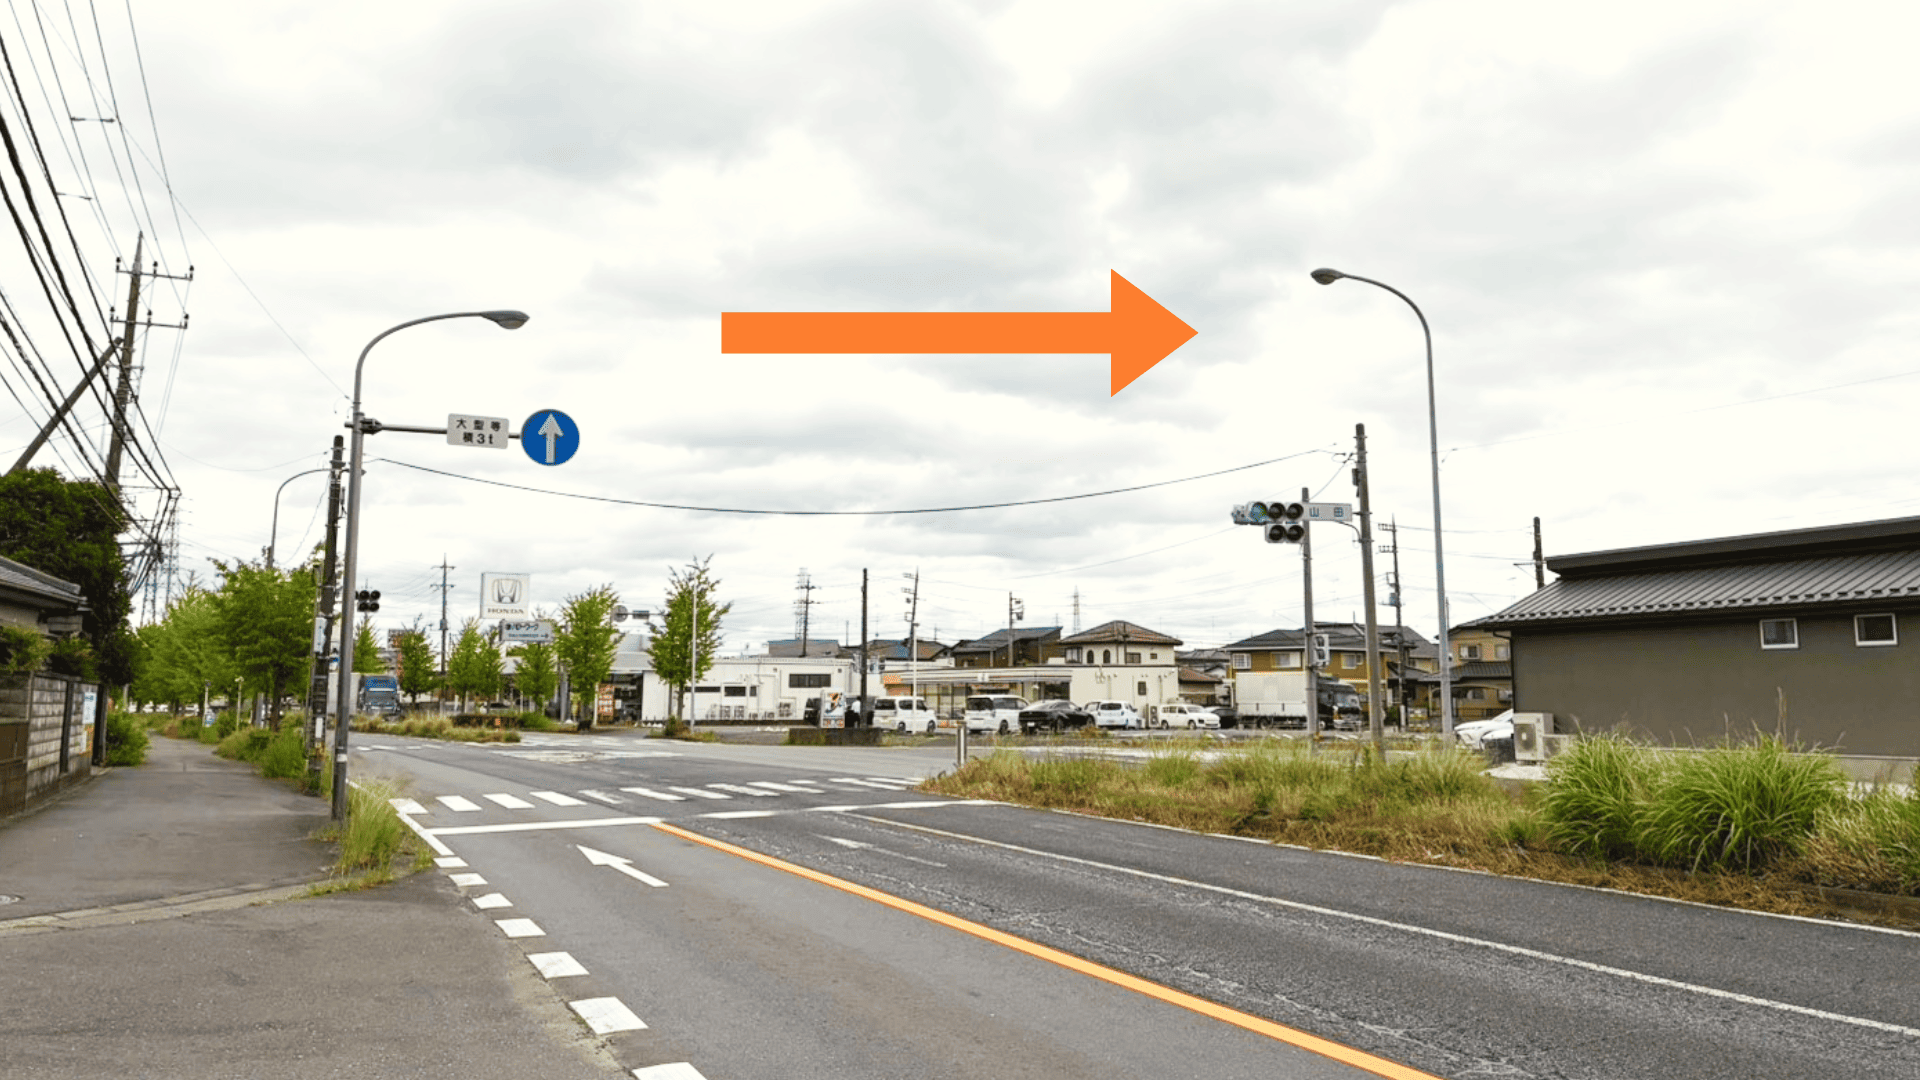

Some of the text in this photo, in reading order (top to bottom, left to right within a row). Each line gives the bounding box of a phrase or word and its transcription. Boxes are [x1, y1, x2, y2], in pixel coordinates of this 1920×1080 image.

[456, 418, 501, 432] 大型等
[1309, 506, 1343, 517] 山田
